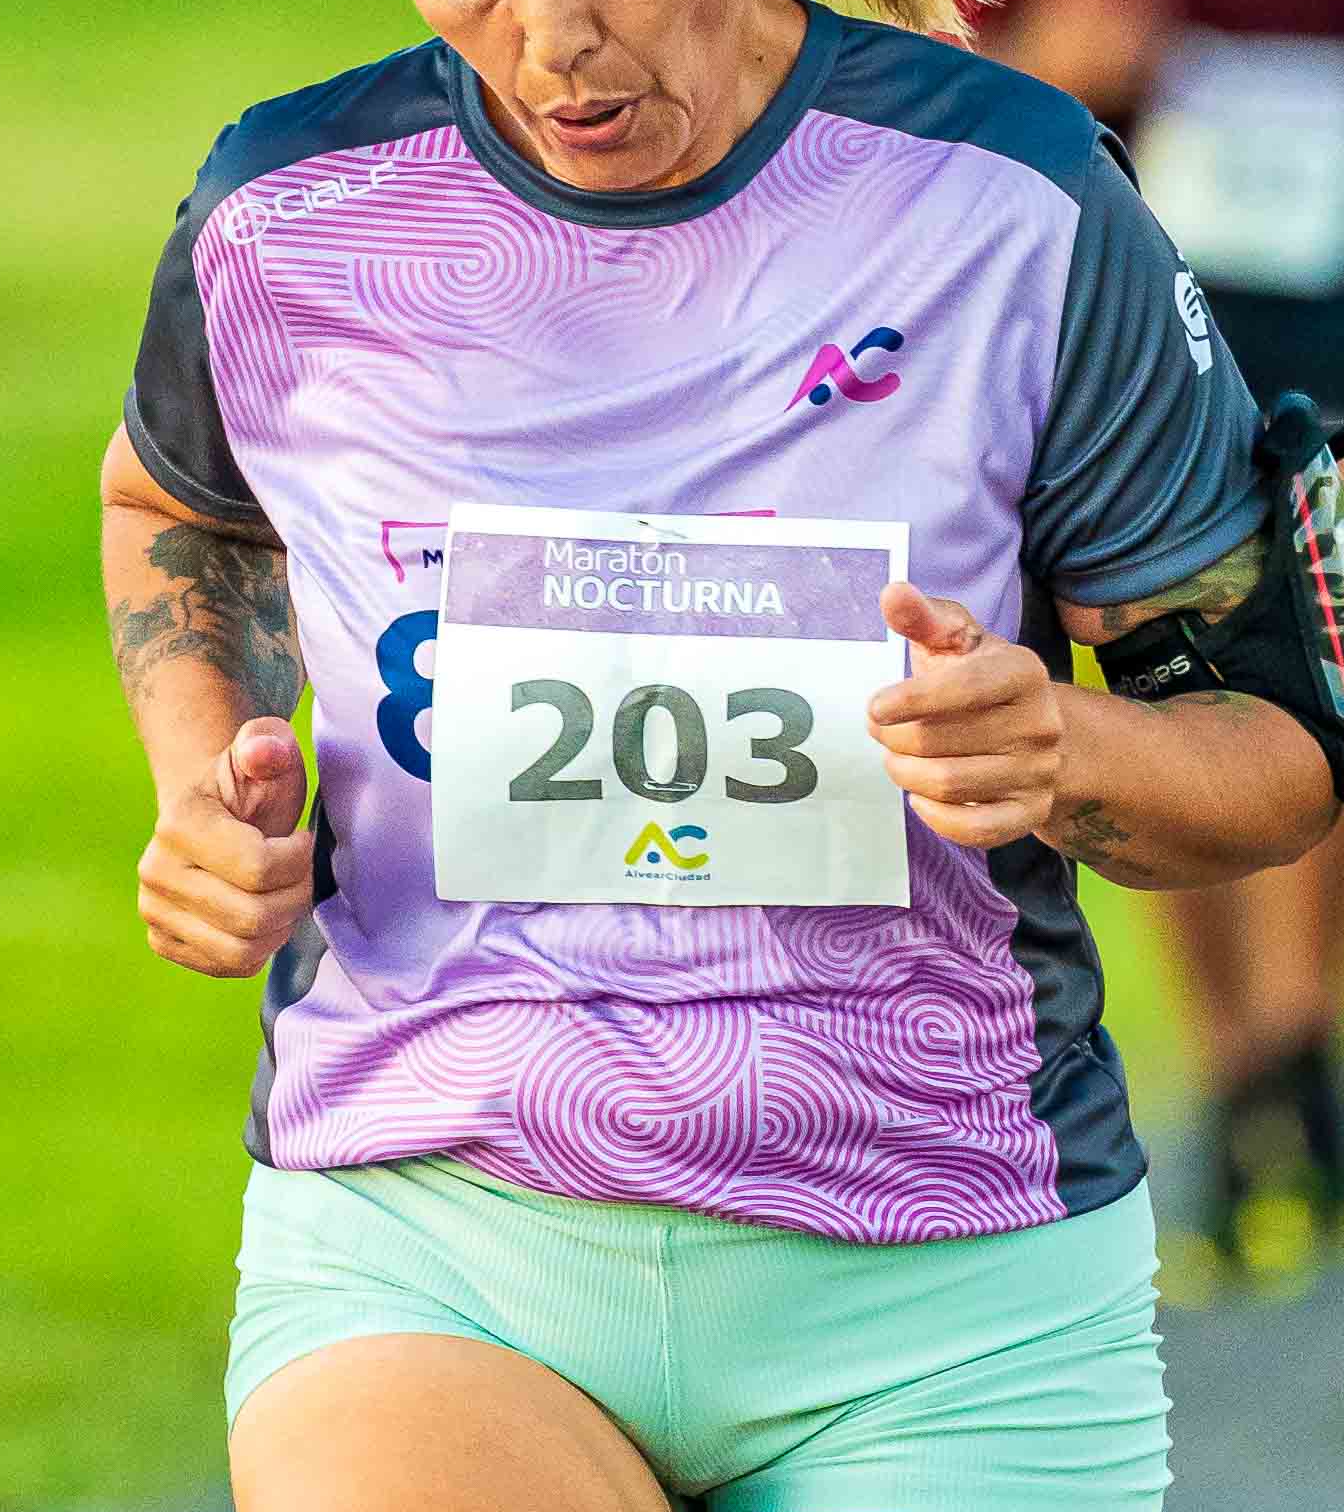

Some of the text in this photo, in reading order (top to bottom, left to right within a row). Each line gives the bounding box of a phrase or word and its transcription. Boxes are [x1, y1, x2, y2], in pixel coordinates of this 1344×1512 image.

[543, 539, 687, 576] Maratón
[542, 575, 785, 615] NOCTURNA
[508, 679, 819, 804] 203
